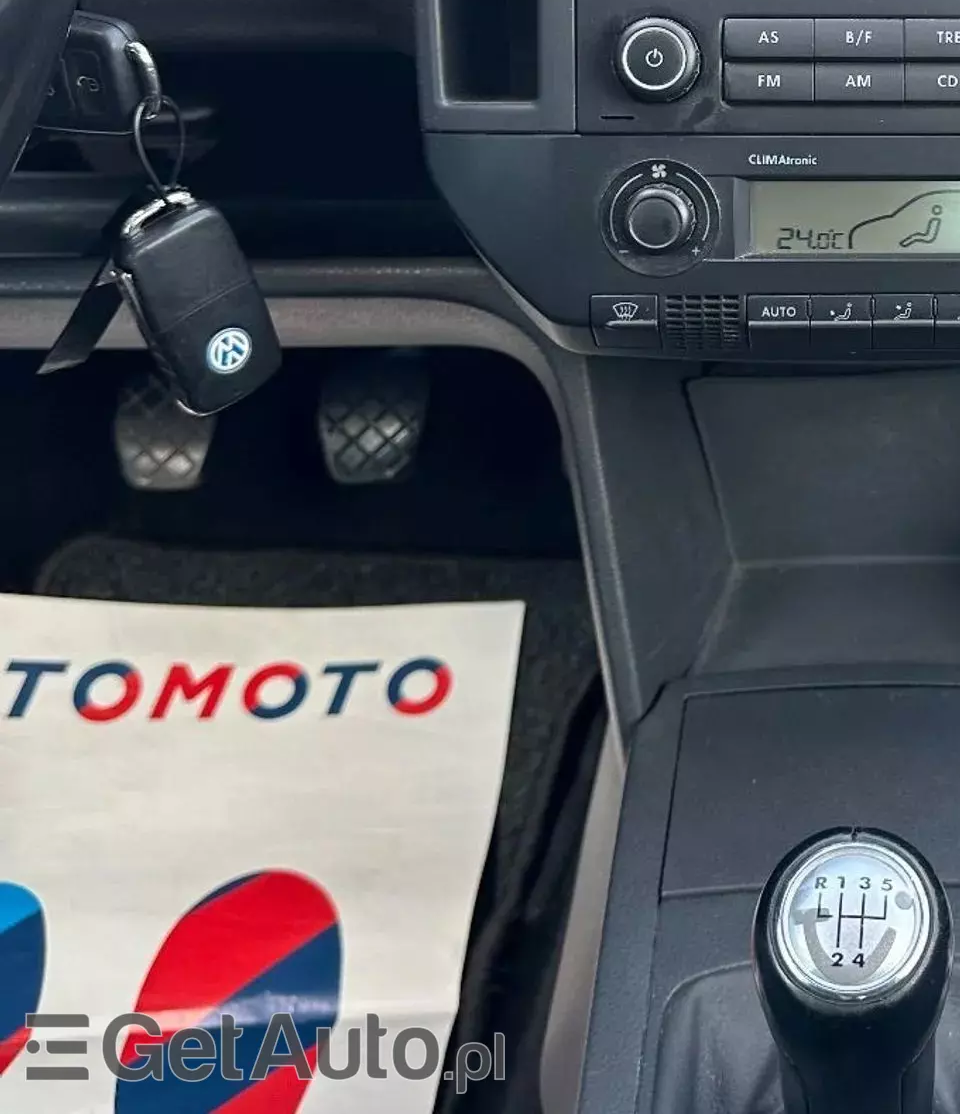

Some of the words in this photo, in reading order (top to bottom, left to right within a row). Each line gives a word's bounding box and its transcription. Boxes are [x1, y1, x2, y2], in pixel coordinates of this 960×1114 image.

[758, 30, 780, 44] AS
[845, 30, 873, 46] B/F
[757, 74, 781, 88] FM
[845, 74, 871, 88] AM
[937, 75, 959, 88] CD
[749, 154, 817, 166] CLIMAtronic
[761, 306, 797, 318] AUTO
[815, 876, 828, 889] R
[837, 876, 845, 889] 1
[859, 876, 871, 889] 3
[881, 879, 893, 892] 5
[831, 952, 844, 967] 2
[852, 953, 865, 968] 4
